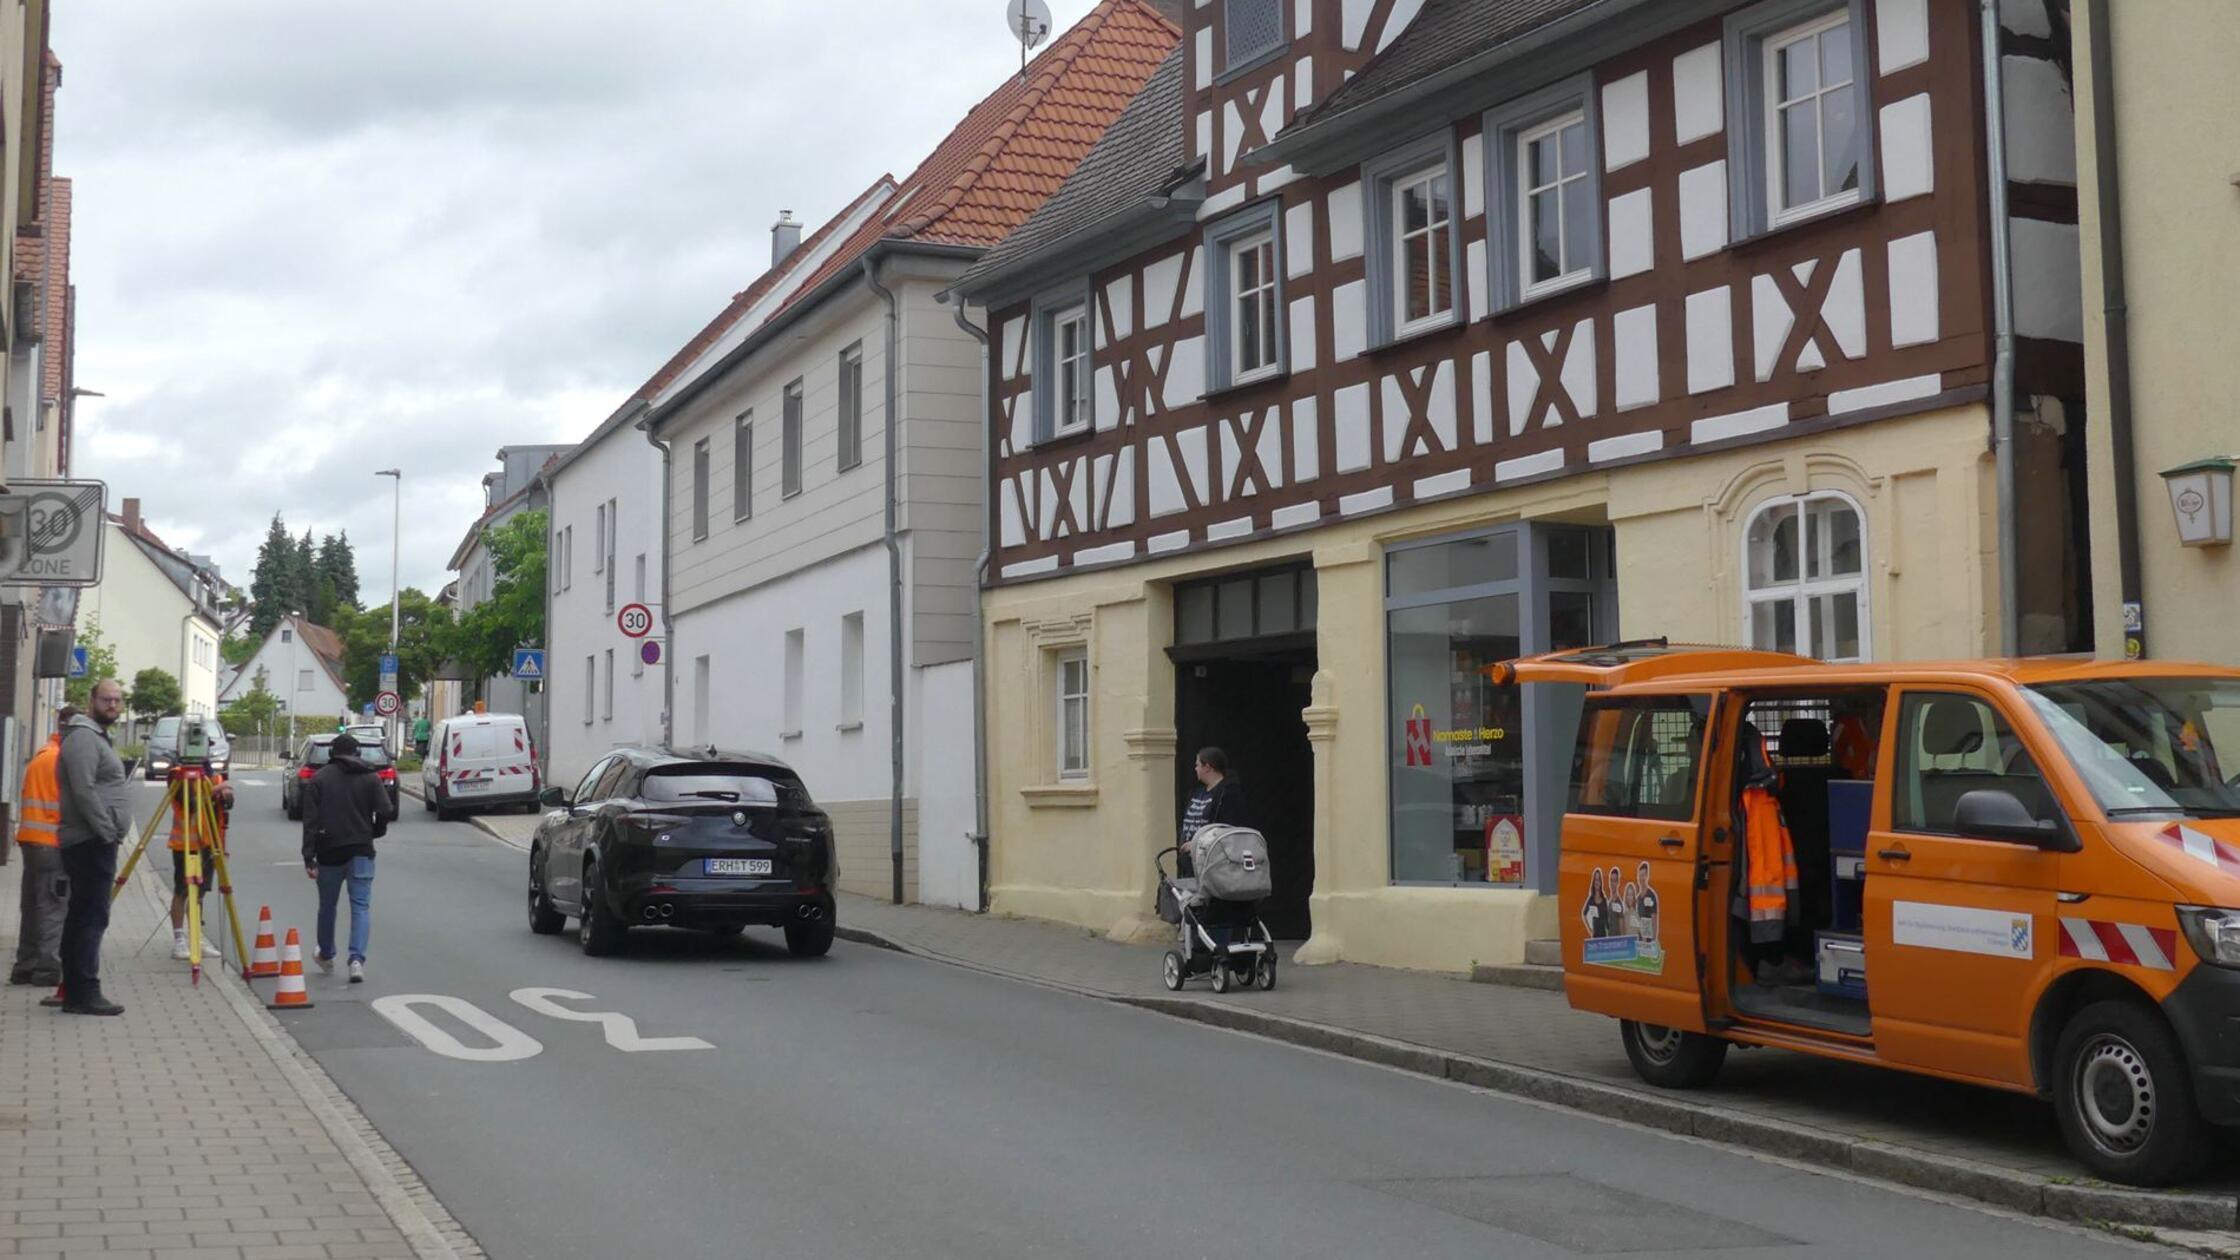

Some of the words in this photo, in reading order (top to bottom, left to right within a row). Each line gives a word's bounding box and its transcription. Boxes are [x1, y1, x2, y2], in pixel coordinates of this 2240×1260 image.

[31, 508, 68, 537] 30
[625, 612, 645, 628] 30
[382, 697, 394, 708] 30
[1479, 727, 1504, 740] Herzo
[711, 860, 733, 872] ERH
[740, 861, 746, 871] T
[749, 861, 769, 872] 599
